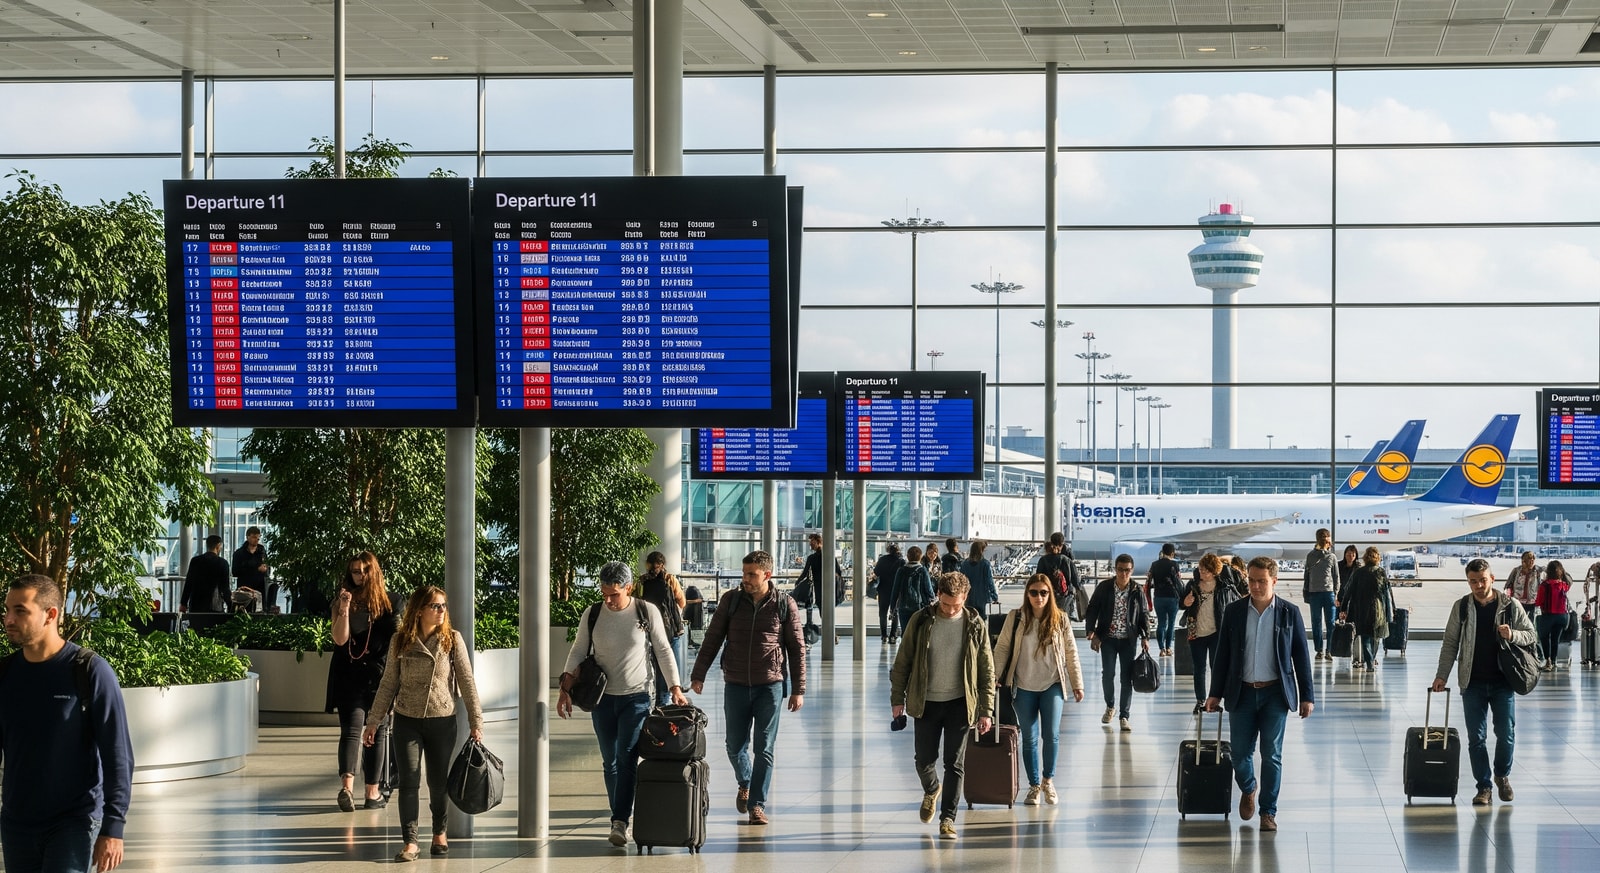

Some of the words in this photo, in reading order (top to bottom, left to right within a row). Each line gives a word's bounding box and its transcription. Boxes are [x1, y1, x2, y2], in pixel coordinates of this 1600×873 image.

[185, 194, 265, 213] Departure
[269, 194, 285, 209] 11
[496, 193, 577, 212] Departure
[580, 192, 597, 207] 11
[845, 377, 888, 387] Departure
